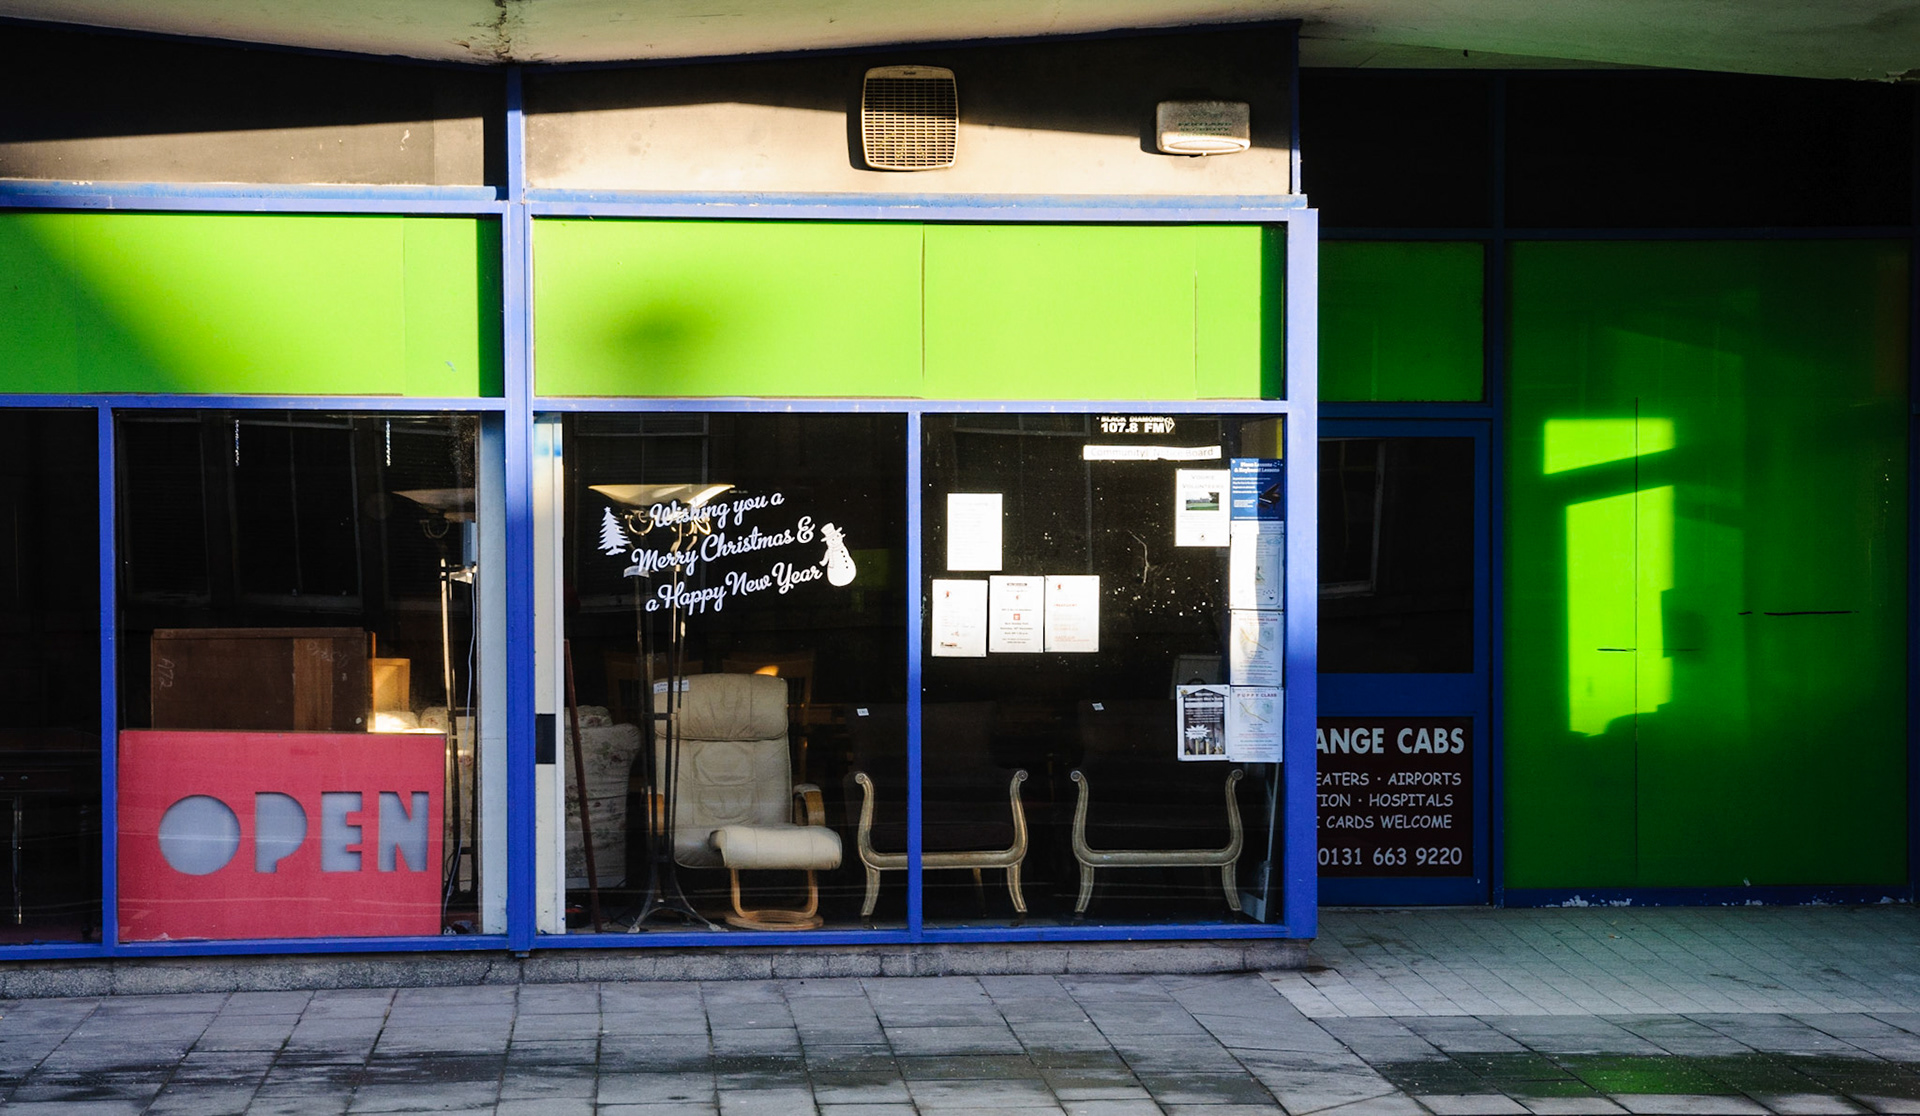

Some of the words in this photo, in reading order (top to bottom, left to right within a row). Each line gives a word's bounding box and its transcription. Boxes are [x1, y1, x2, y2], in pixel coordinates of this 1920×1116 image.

[1101, 422, 1138, 433] 107.8
[1144, 422, 1165, 433] FM
[649, 500, 730, 529] Wishing
[733, 494, 769, 526] you
[770, 492, 785, 507] a
[631, 549, 698, 577] Merry
[700, 526, 795, 562] Christmas
[797, 516, 815, 544] &
[645, 599, 660, 612] a
[658, 582, 726, 616] Happy
[725, 571, 773, 596] New
[771, 562, 825, 595] Year
[1316, 728, 1384, 754] ANGE
[1397, 728, 1464, 754] CABS
[1387, 771, 1462, 786] AIRPORTS
[1369, 793, 1454, 807] HOSPITALS
[1326, 815, 1374, 829] CARDS
[1380, 814, 1453, 829] WELCOME
[158, 790, 429, 876] OPEN
[1317, 847, 1363, 866] 0131
[1373, 847, 1407, 866] 663
[1415, 847, 1463, 866] 9220
